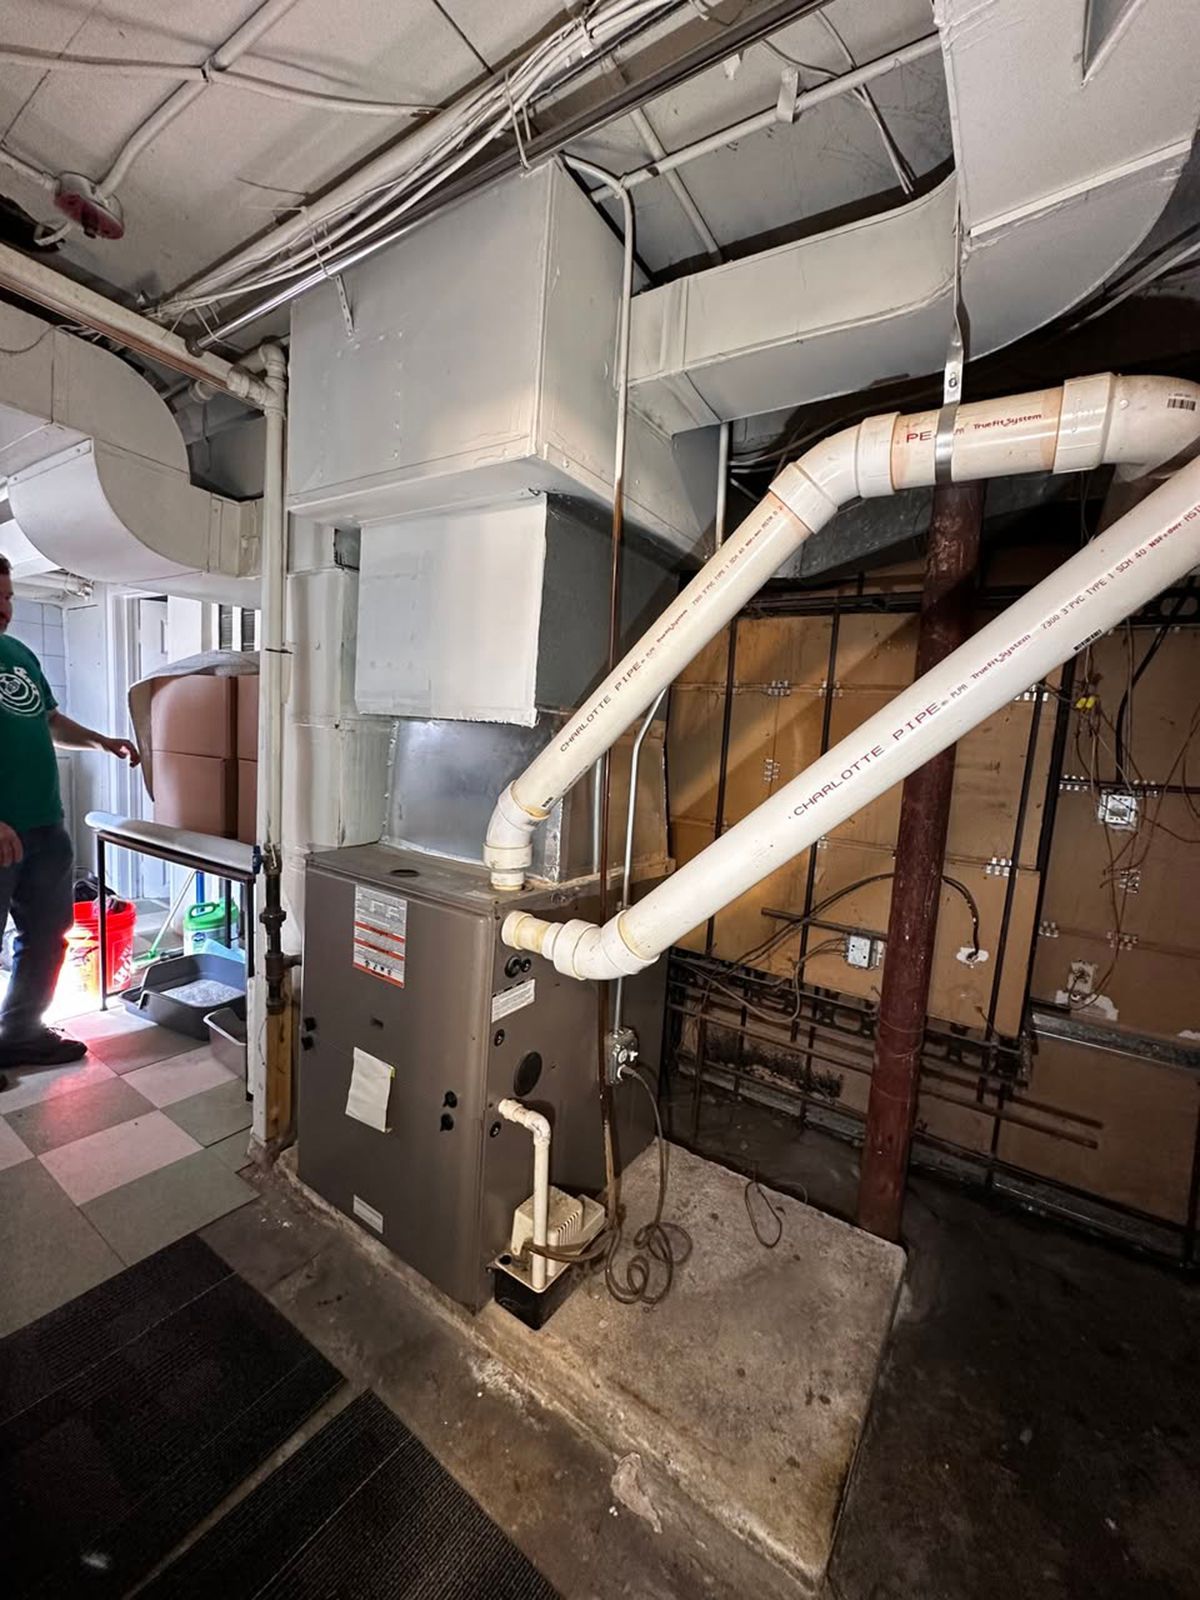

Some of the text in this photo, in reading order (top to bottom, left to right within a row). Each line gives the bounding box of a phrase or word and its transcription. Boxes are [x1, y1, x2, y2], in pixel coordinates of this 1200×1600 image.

[560, 695, 612, 752] CHARLOTTE
[614, 664, 642, 691] PIPE
[793, 745, 885, 816] CHARLOTTE
[892, 702, 941, 741] PIPE
[1086, 578, 1108, 597] TYPE
[1115, 559, 1134, 573] SCH
[1135, 548, 1147, 558] 40
[1183, 504, 1200, 522] AST
